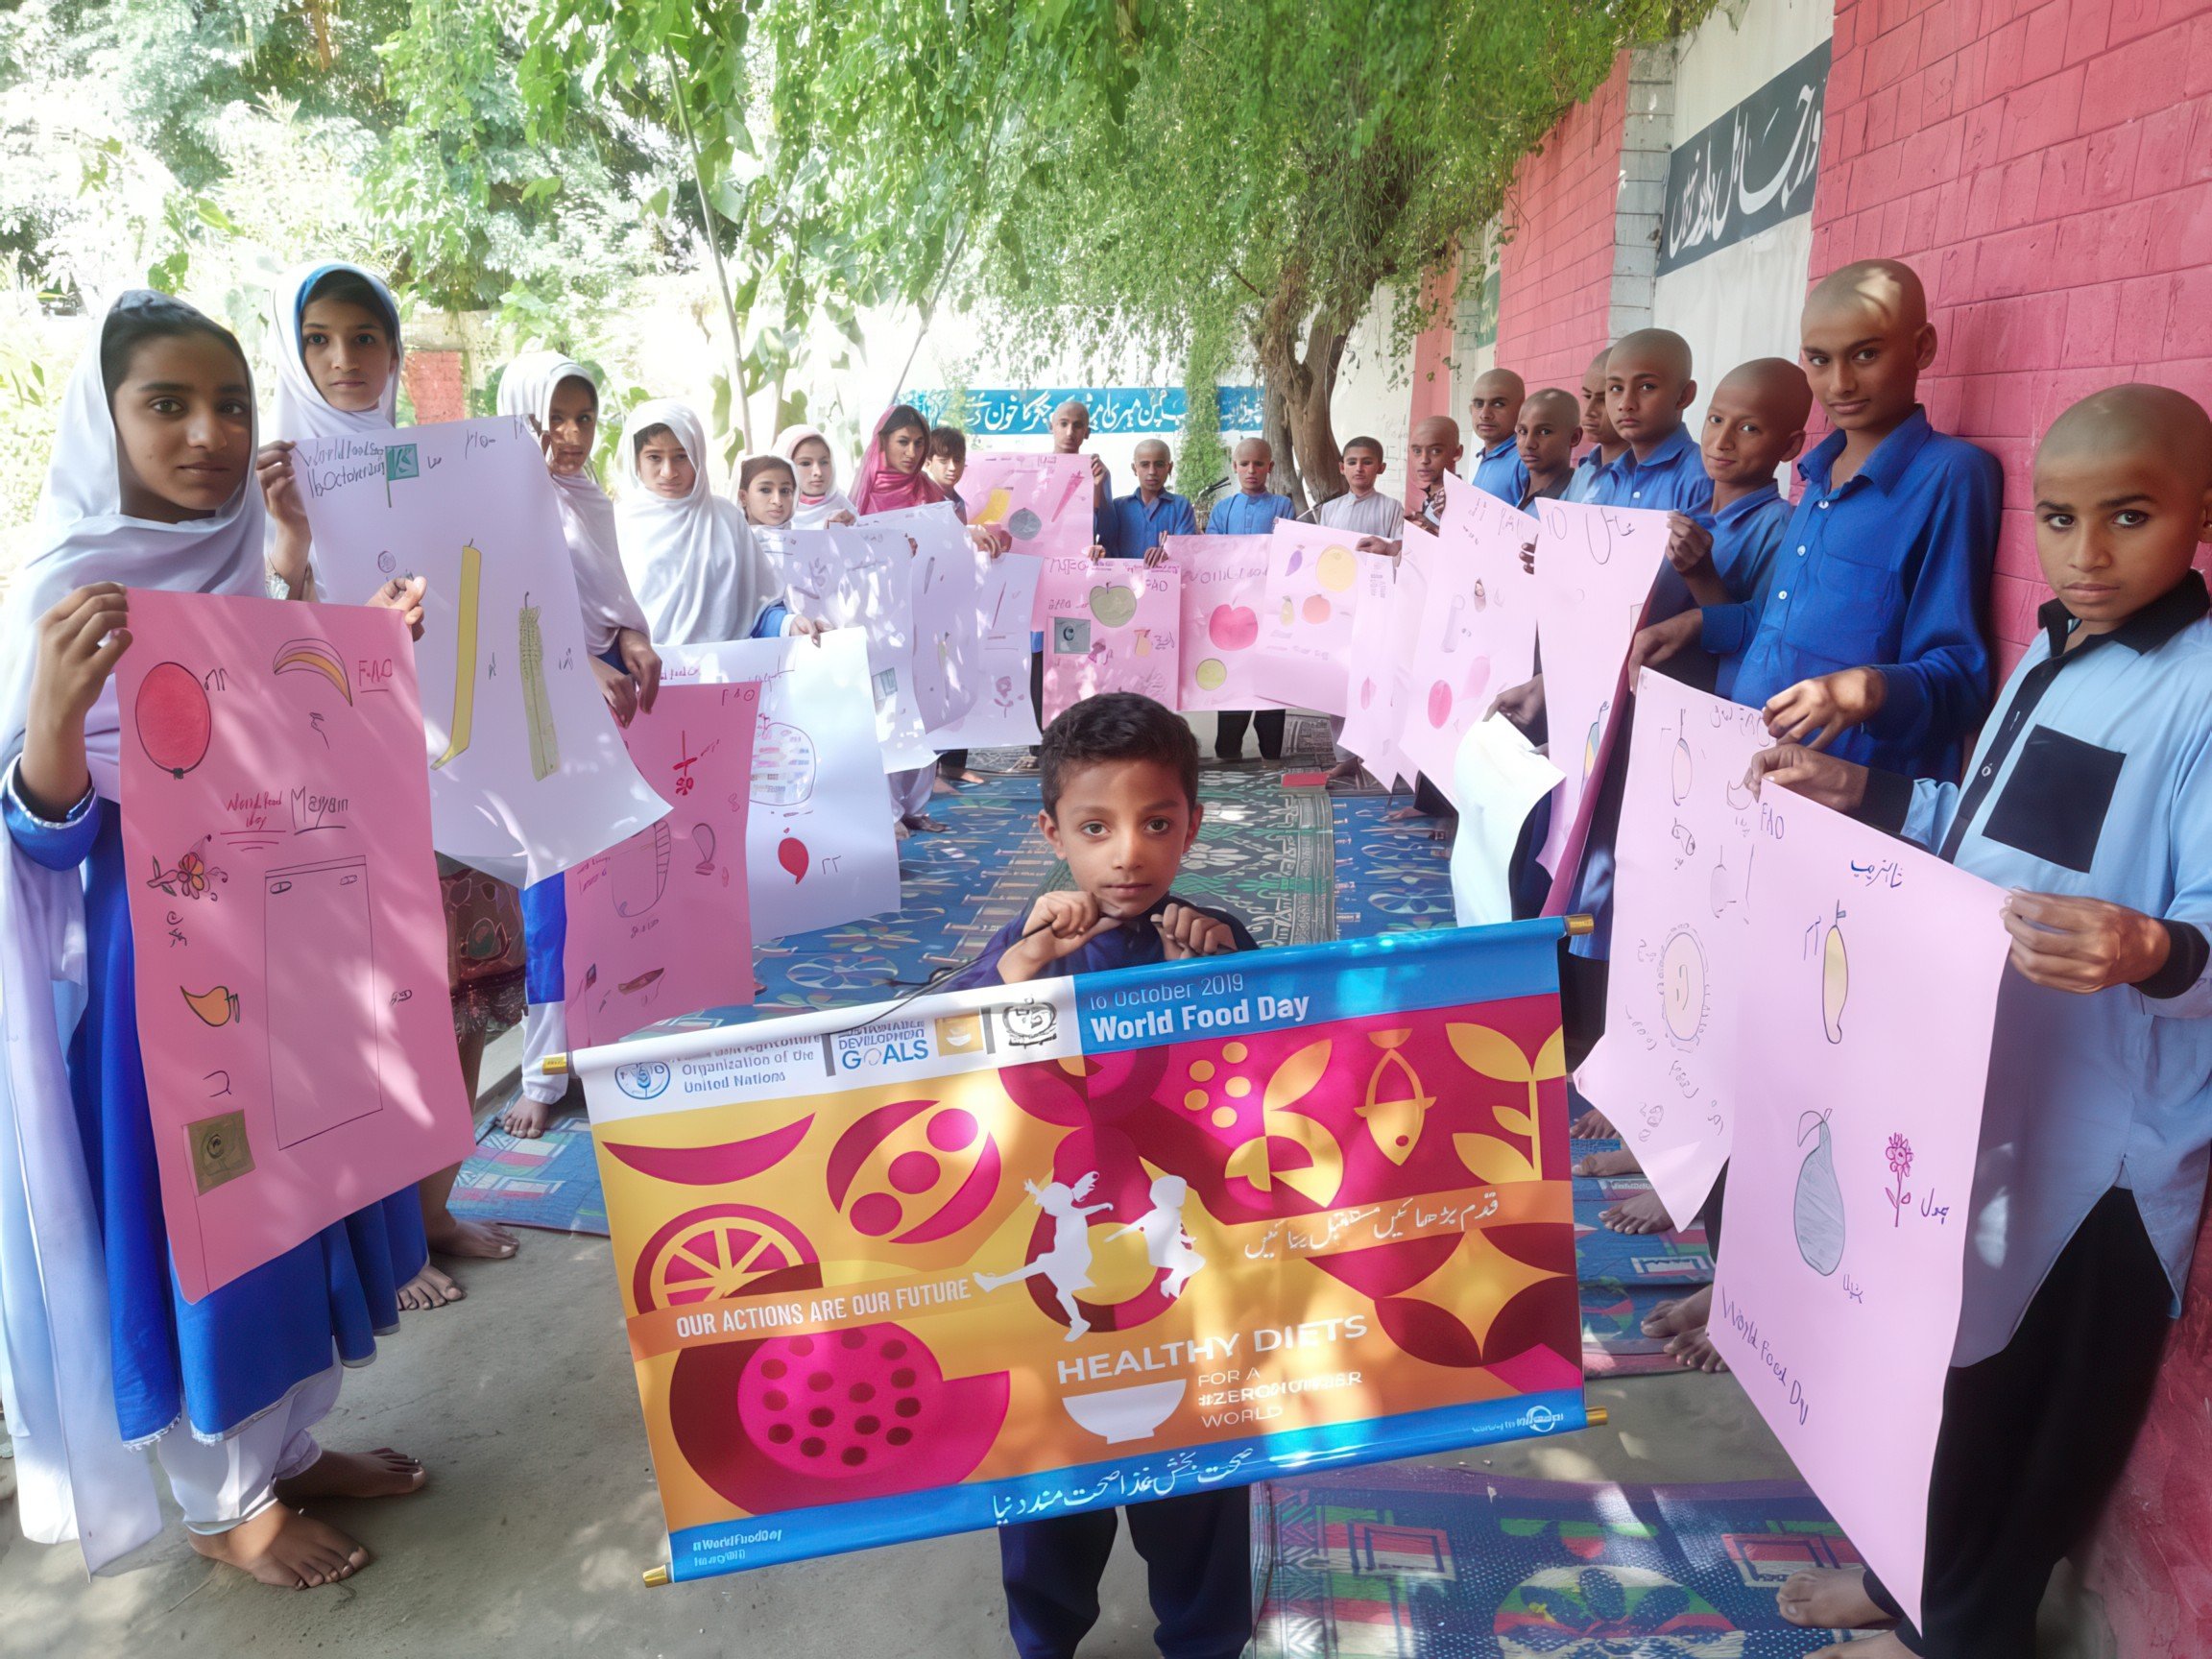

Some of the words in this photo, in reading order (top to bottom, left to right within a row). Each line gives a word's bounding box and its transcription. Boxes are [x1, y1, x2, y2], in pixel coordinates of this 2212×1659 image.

[1201, 974, 1243, 997] 2019
[1091, 1008, 1174, 1043] World
[1182, 998, 1249, 1031] Food
[1257, 996, 1310, 1022] Day
[682, 1052, 771, 1078] Organization
[774, 1050, 787, 1064] of
[842, 1039, 929, 1070] GOALS
[684, 1076, 729, 1094] United
[733, 1071, 786, 1087] Nations
[1460, 1190, 1499, 1231] قدم
[676, 1311, 717, 1338] OUR
[723, 1303, 804, 1332] ACTIONS
[809, 1297, 848, 1323] ARE
[852, 1291, 892, 1316] OUR
[897, 1278, 972, 1310] FUTURE
[1057, 1333, 1240, 1384] HEALTHY
[1253, 1314, 1368, 1353] DIETS
[1197, 1369, 1240, 1387] FOR
[1245, 1366, 1261, 1381] A
[1201, 1406, 1284, 1429] WORLD
